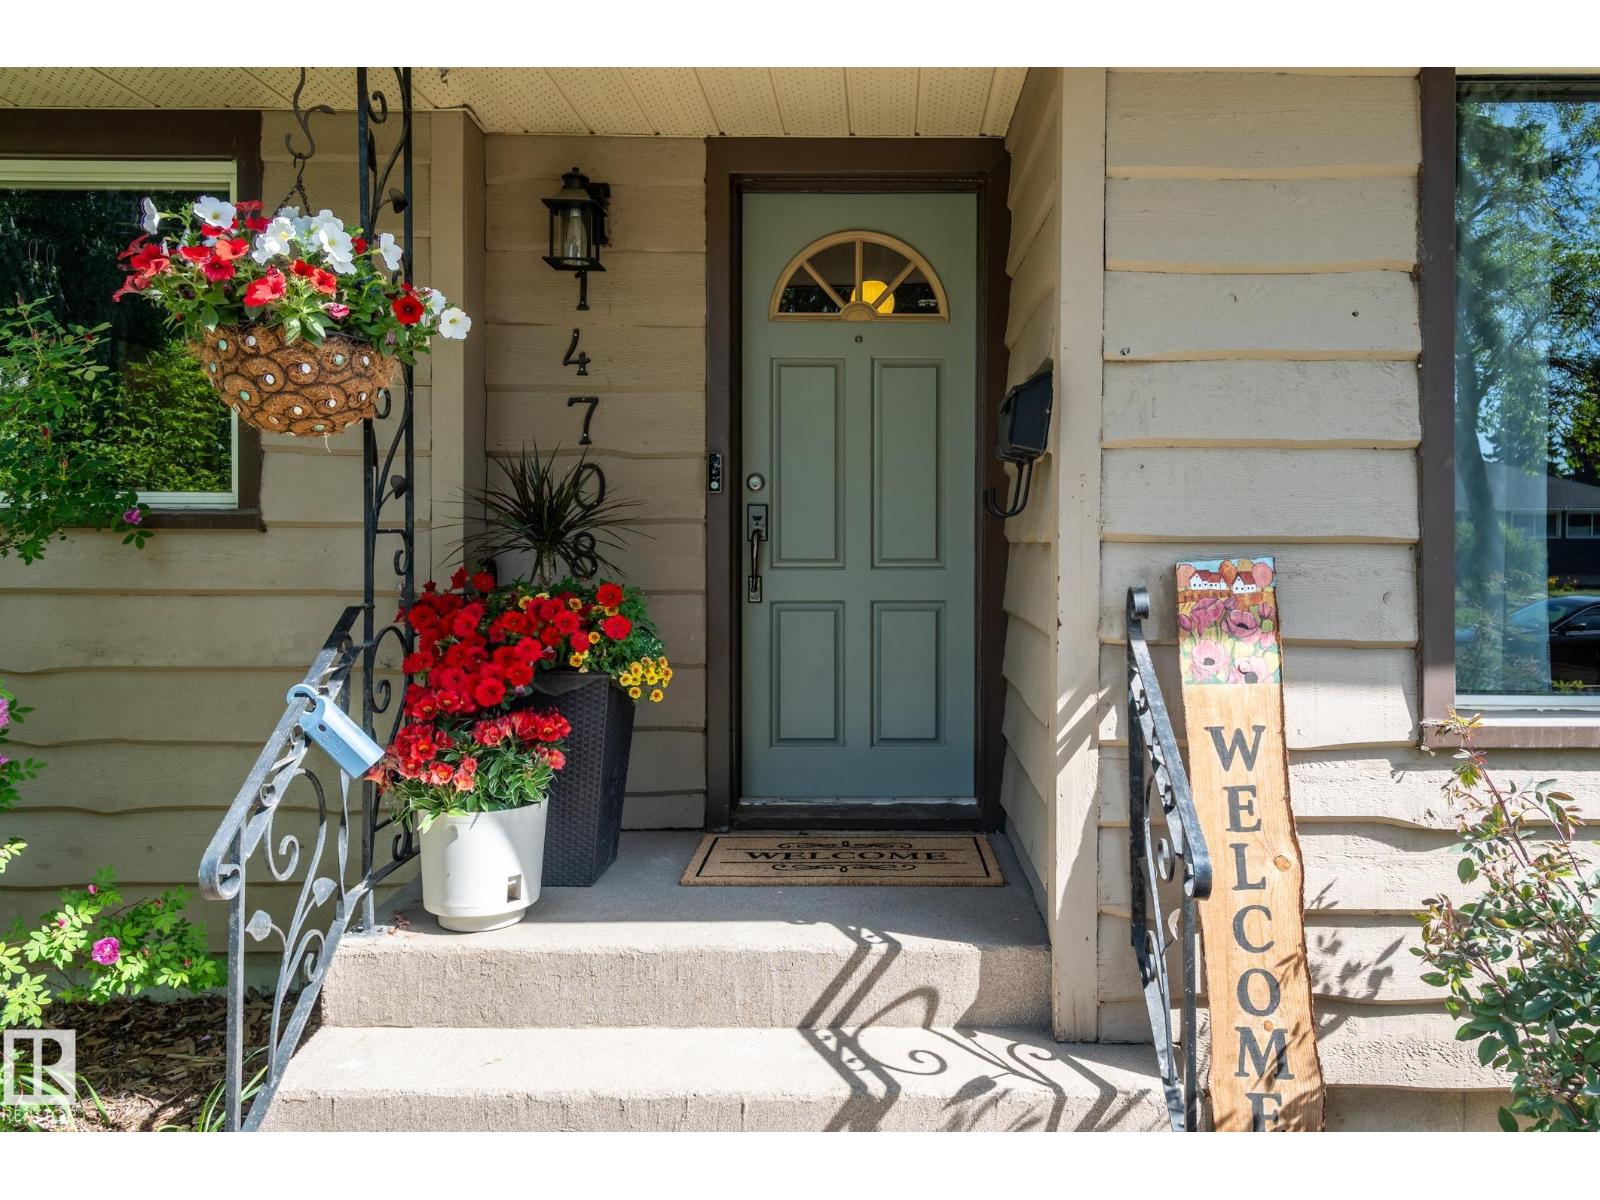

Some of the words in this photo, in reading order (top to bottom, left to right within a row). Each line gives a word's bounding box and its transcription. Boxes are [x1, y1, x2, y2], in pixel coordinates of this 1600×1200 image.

[562, 269, 605, 578] 14708
[745, 850, 948, 861] WELCOME
[1204, 725, 1295, 1132] WELCOME
